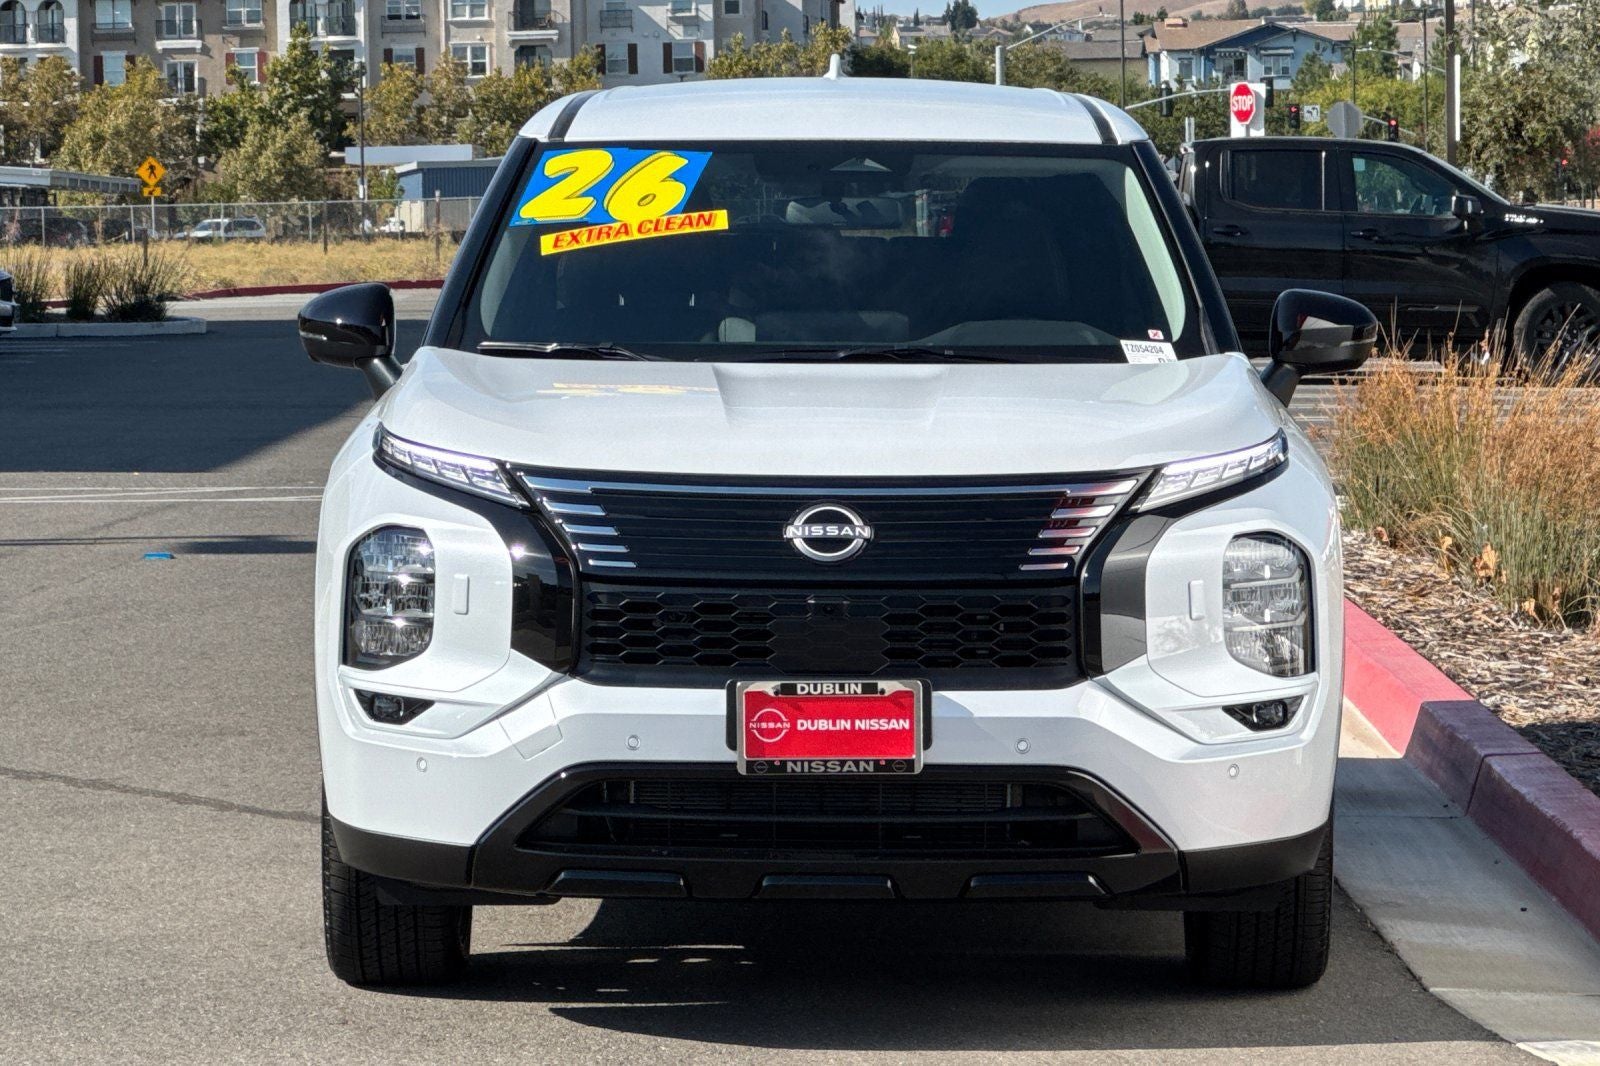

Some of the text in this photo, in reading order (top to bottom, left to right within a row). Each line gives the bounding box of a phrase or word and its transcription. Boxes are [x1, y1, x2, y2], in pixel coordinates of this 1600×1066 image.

[1232, 95, 1253, 111] STOP
[519, 149, 689, 224] 26
[552, 212, 715, 248] EXTRA CLEAN
[789, 525, 869, 537] NISSAN
[796, 682, 863, 695] DUBLIN
[797, 718, 909, 731] DUBLIN NISSAN
[787, 760, 874, 773] NISSAN
